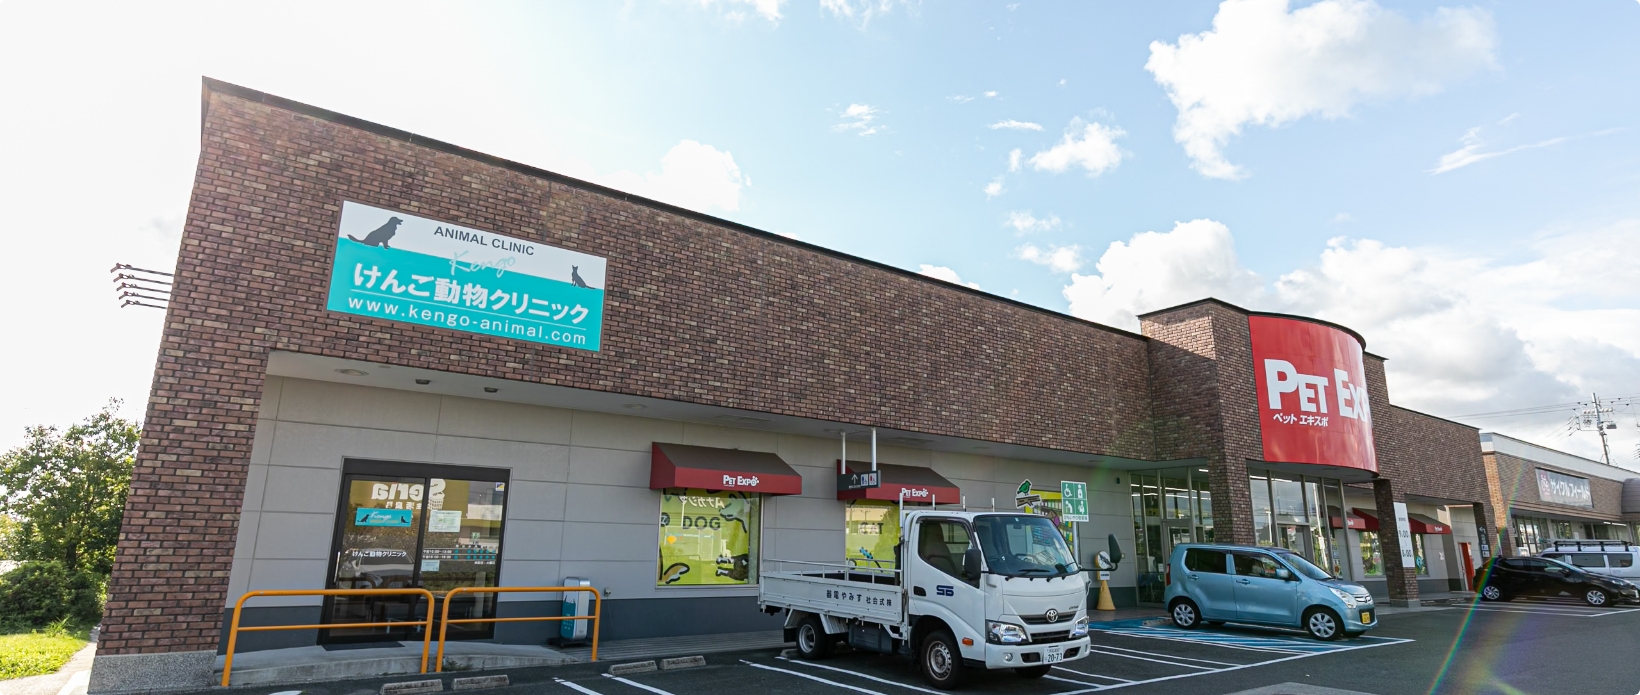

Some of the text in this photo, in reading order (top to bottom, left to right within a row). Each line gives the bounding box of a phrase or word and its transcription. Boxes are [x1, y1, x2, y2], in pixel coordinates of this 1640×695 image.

[434, 226, 534, 256] ANIMAL CLINIC
[449, 250, 516, 278] Kengo
[353, 263, 589, 324] けんご動物クリニック
[348, 297, 587, 345] www.kengo-animal.com
[1264, 358, 1329, 414] PET
[1273, 413, 1329, 428] ペット エキスポ
[723, 475, 736, 485] PET
[682, 515, 721, 531] DOG
